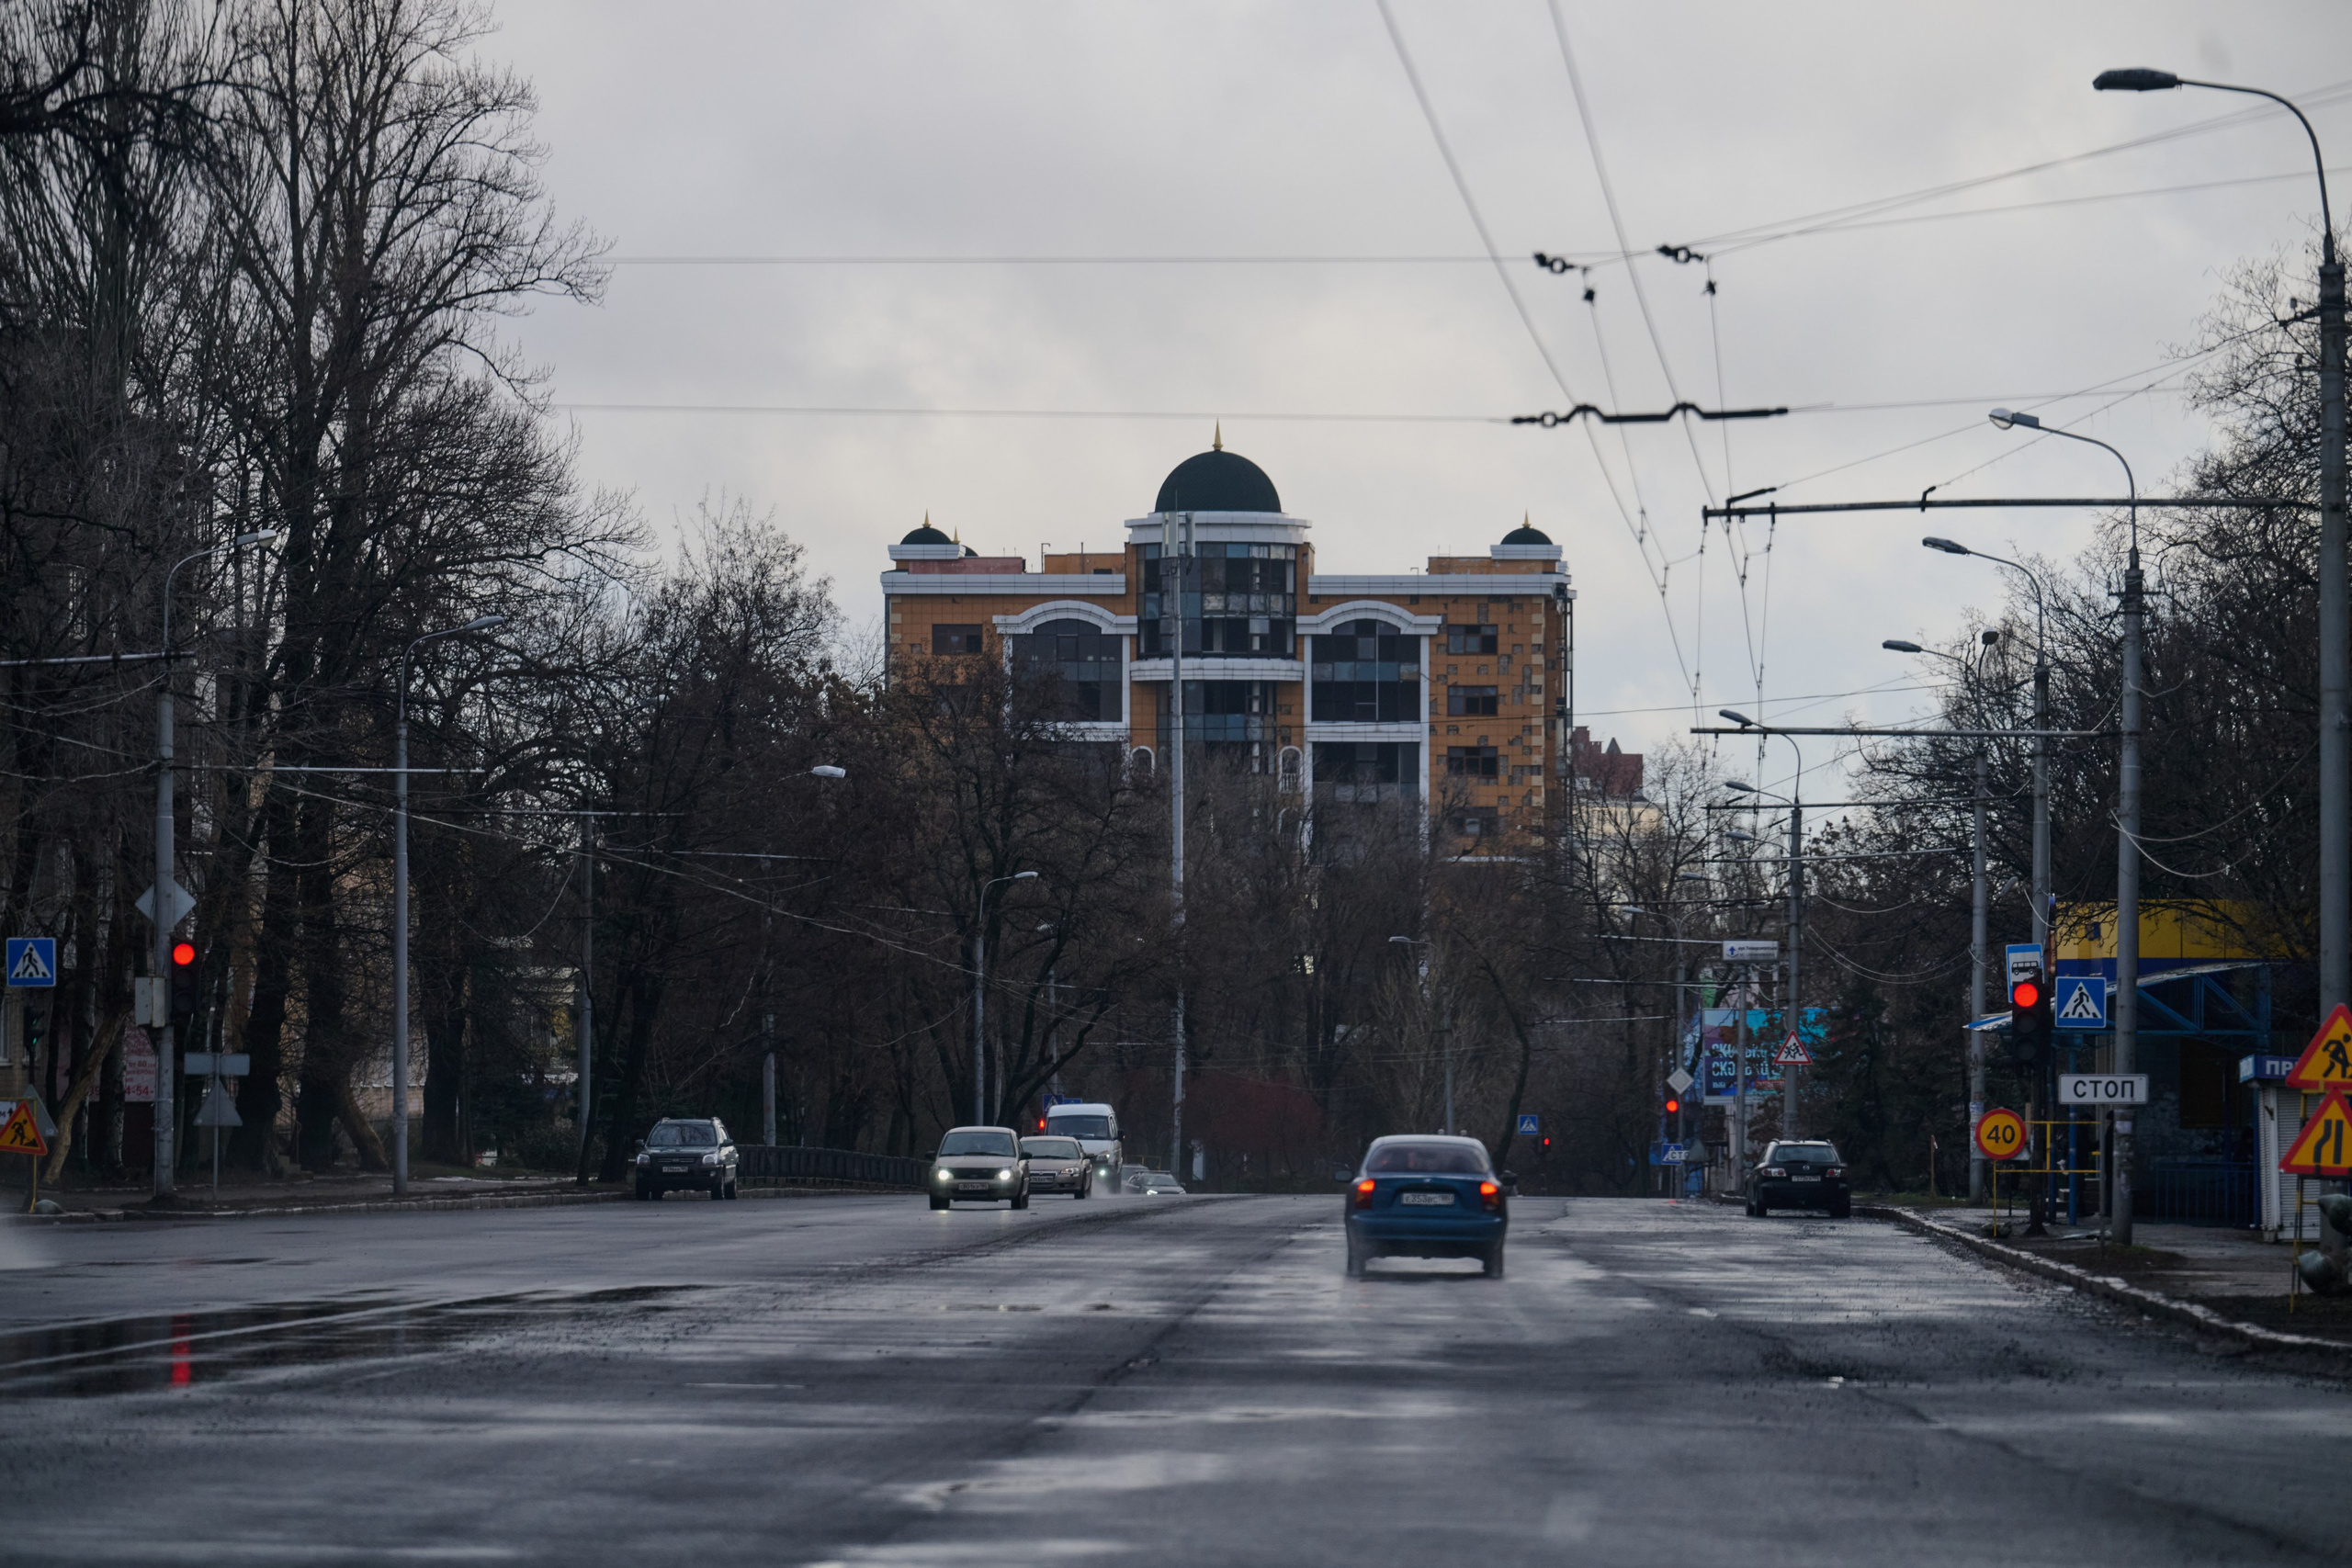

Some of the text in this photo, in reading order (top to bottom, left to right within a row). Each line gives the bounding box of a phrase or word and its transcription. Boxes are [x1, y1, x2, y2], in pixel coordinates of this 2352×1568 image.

[2265, 1059, 2299, 1076] ПР
[2073, 1079, 2134, 1099] СТОП
[1986, 1124, 2016, 1144] 40
[1670, 1151, 1690, 1159] СТО
